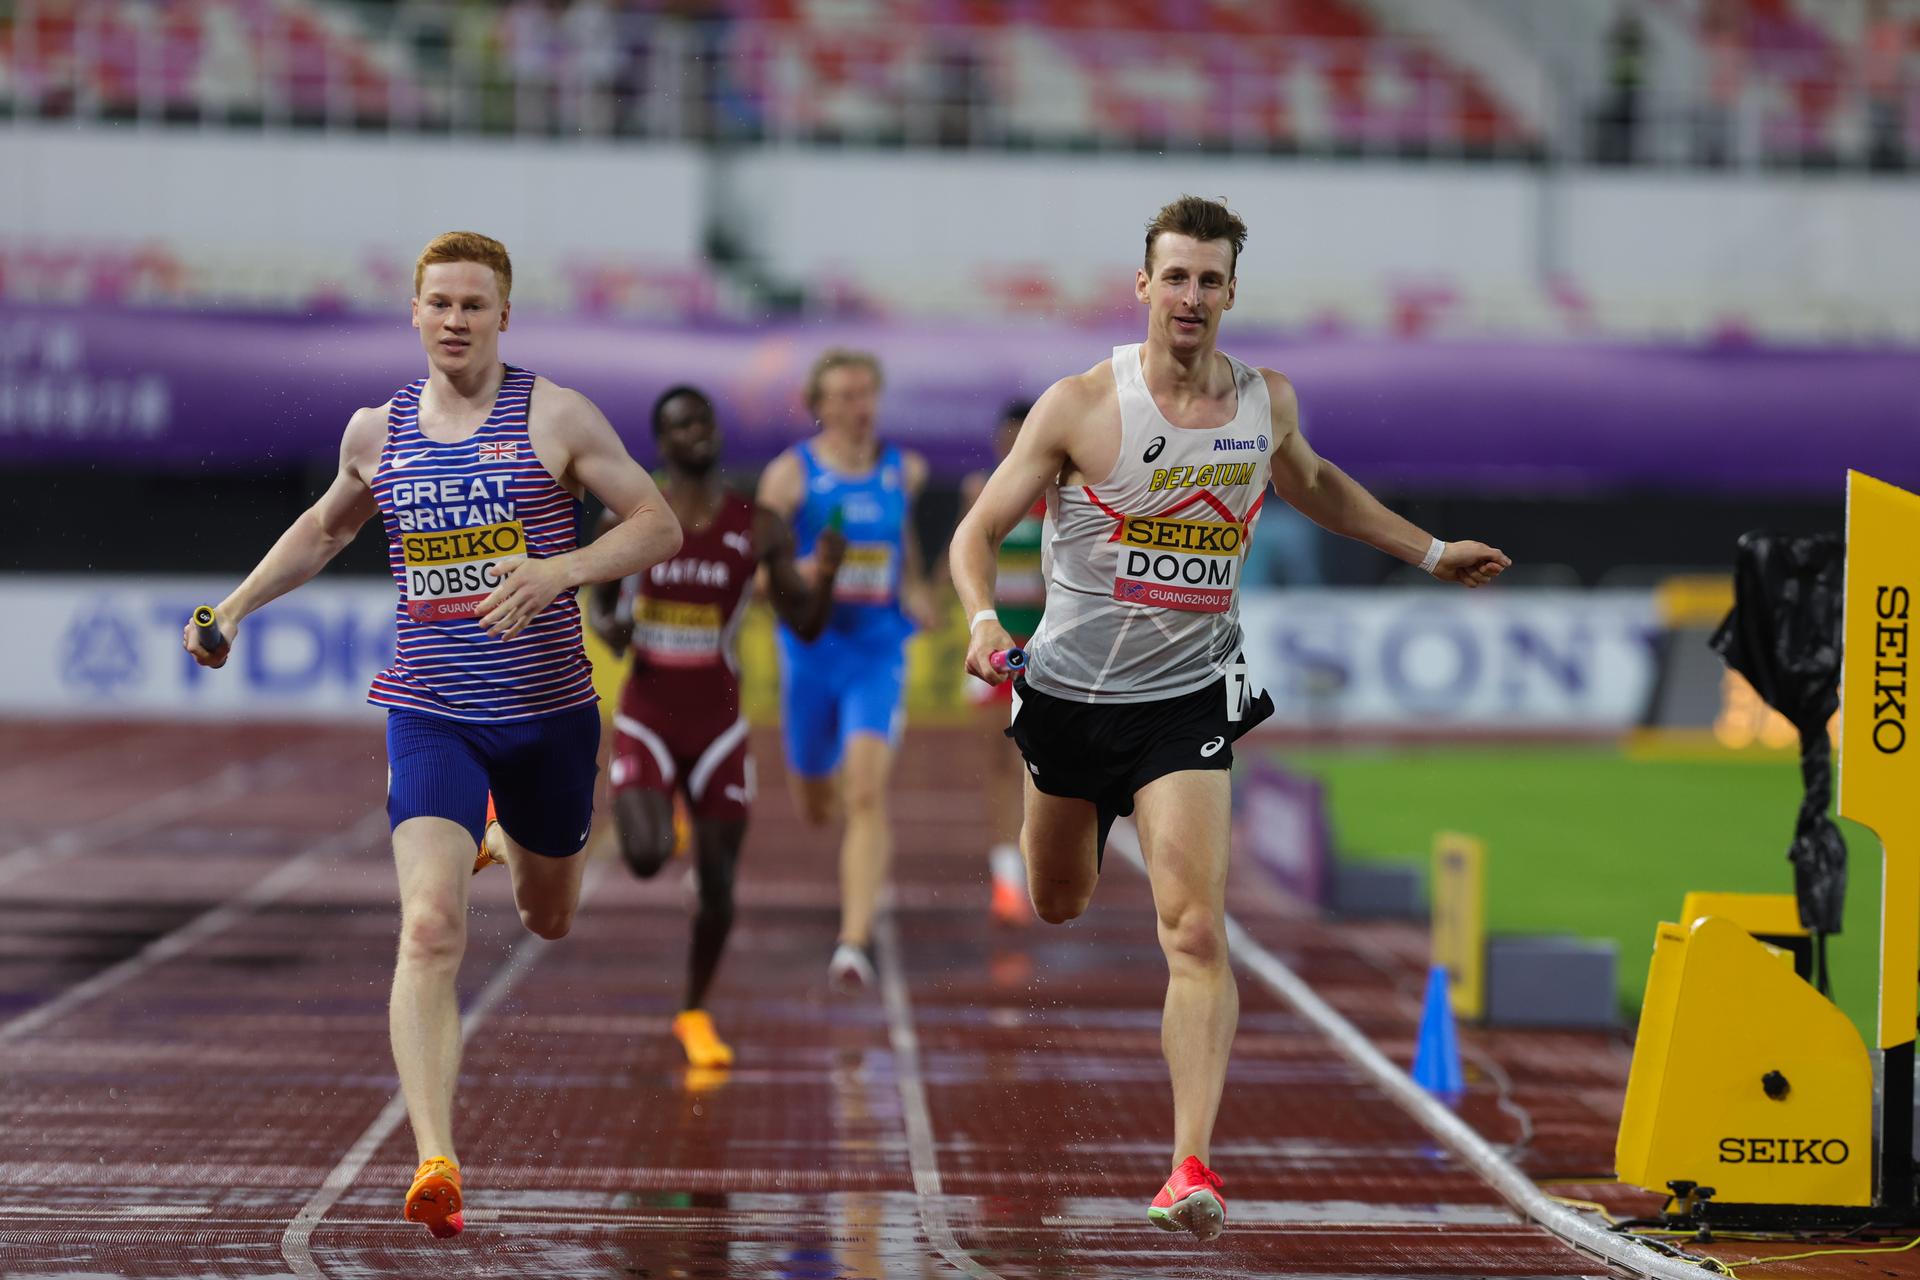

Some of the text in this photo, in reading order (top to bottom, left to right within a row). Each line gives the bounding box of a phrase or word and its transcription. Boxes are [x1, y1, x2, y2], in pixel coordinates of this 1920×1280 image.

[1213, 438, 1256, 452] Allianz
[391, 474, 513, 507] GREAT
[1148, 462, 1256, 492] BELGIUM
[394, 501, 514, 531] BRITAIN
[405, 526, 519, 563] SEIKO
[1127, 519, 1240, 552] SEIKO
[412, 561, 509, 597] DOBSO
[1126, 550, 1232, 586] DOOM
[1149, 590, 1220, 605] GUANGZHOU
[1872, 585, 1910, 755] SEIKO
[1234, 673, 1245, 713] 7
[1719, 1137, 1849, 1165] SEIKO
